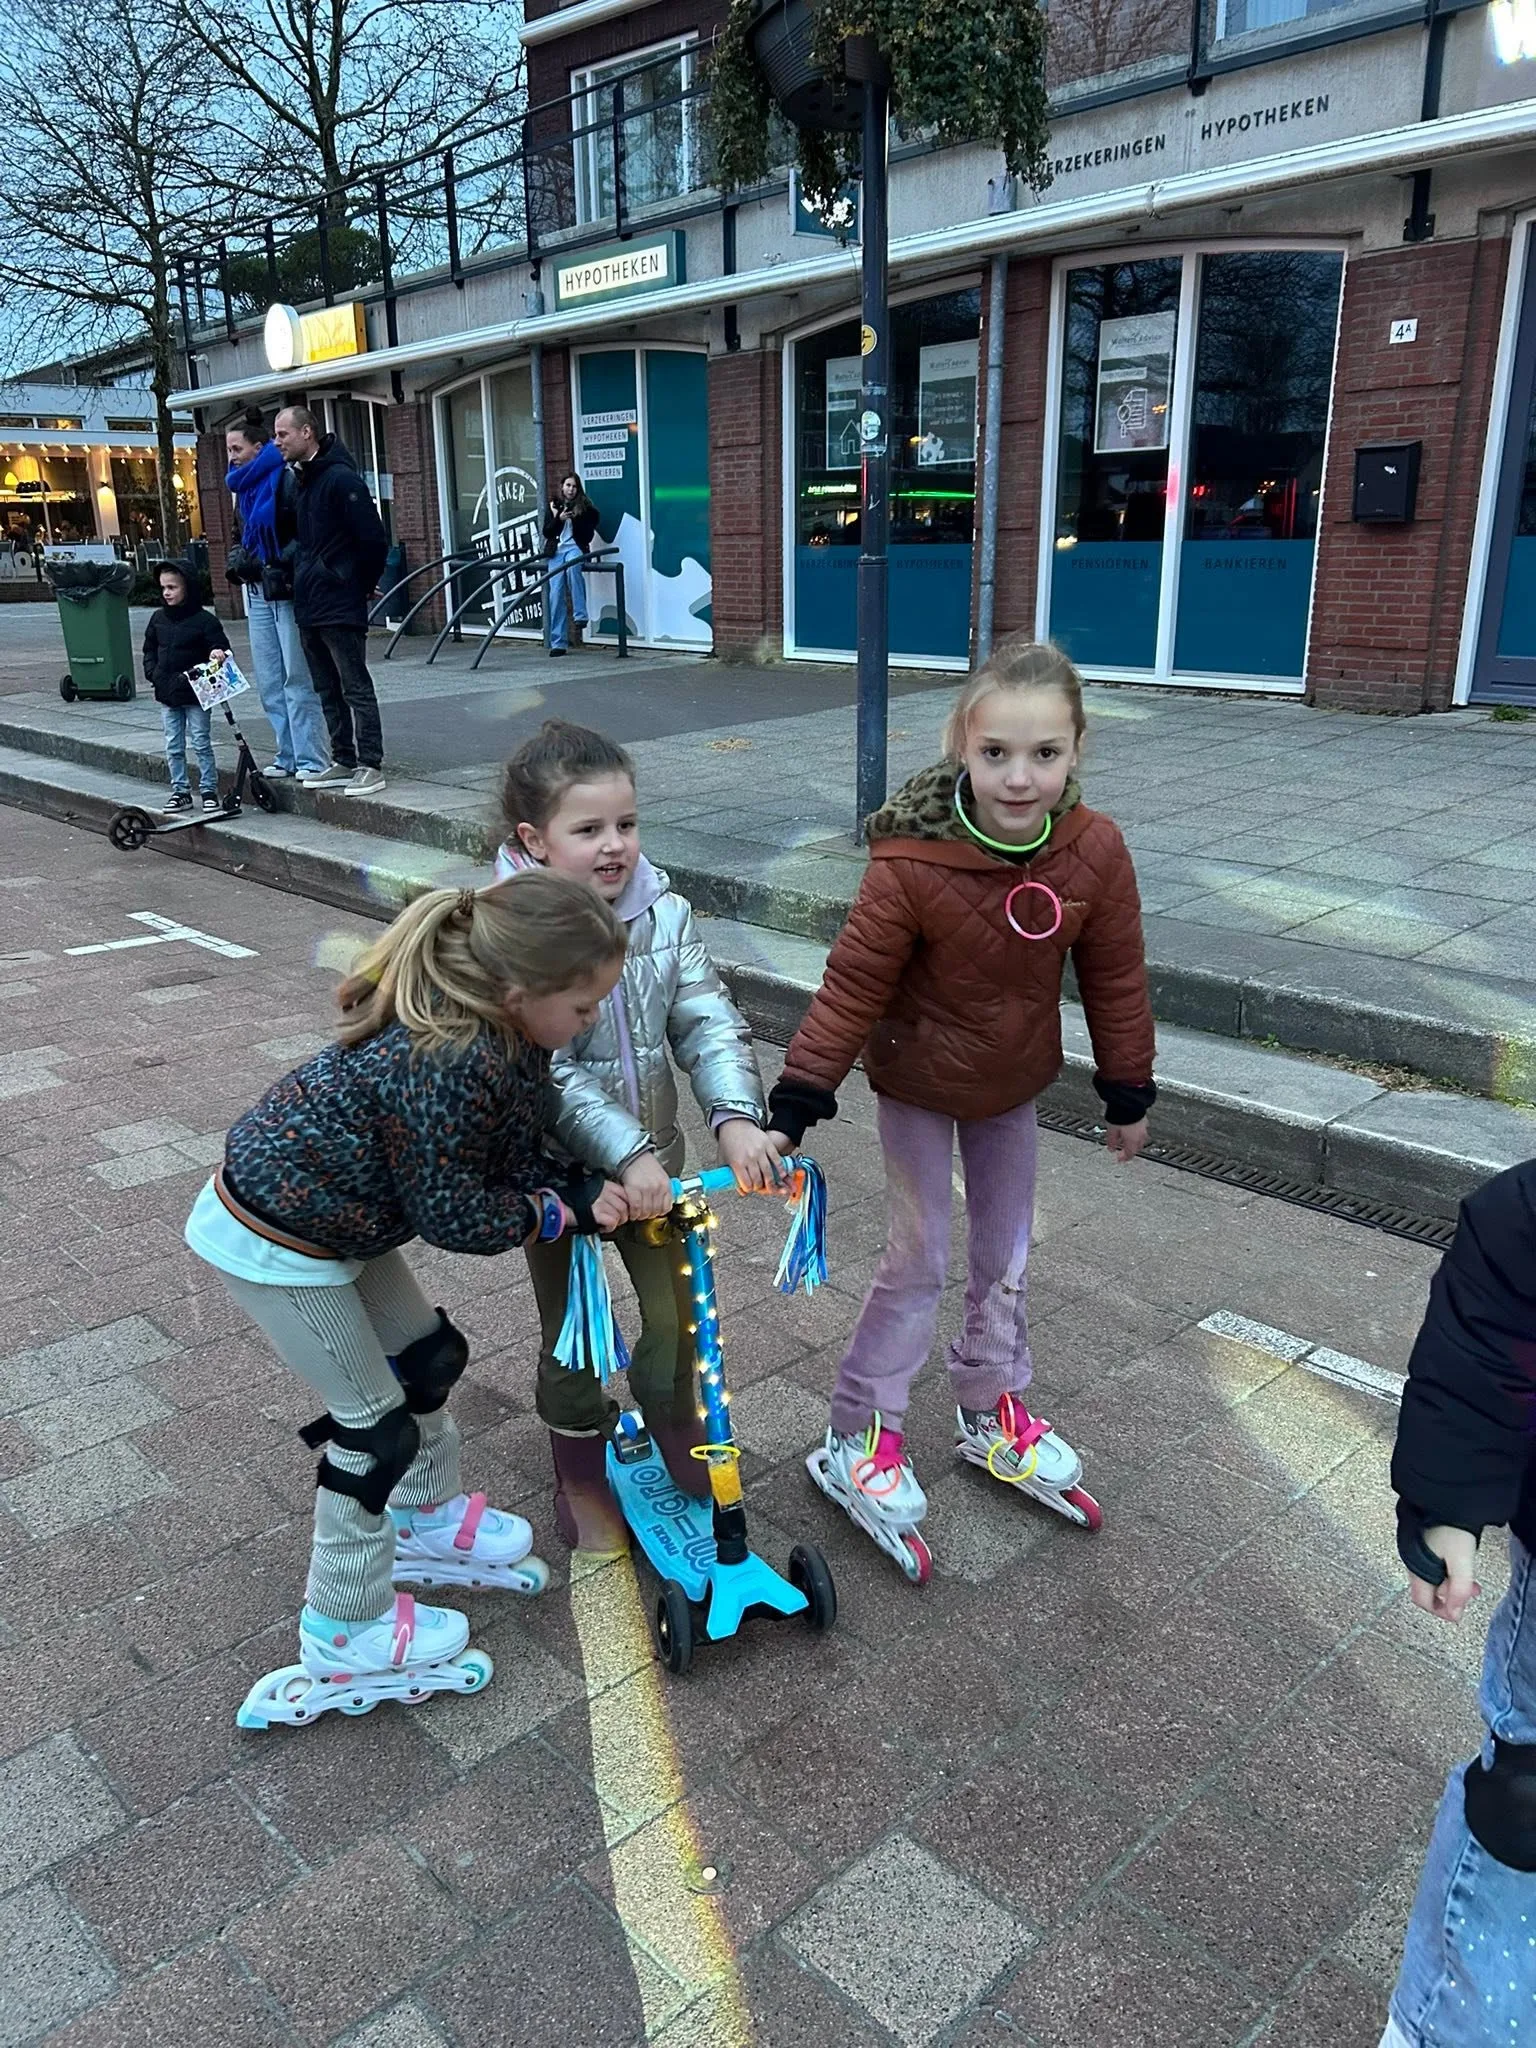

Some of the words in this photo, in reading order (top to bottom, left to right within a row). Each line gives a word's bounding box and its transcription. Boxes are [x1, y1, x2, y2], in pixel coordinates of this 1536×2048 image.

[1042, 133, 1166, 175] ERZEKERINGEN
[1201, 94, 1330, 141] HYPOTHEKEN
[564, 252, 660, 292] HYPOTHEKEN
[582, 411, 635, 425] VERZEKERINGEN
[584, 430, 627, 443] HYPOTHEKEN
[584, 449, 624, 461] PENSIOENEN
[585, 467, 621, 479] BANKIEREN
[1071, 558, 1150, 569] PENSIOENEN
[1204, 557, 1287, 569] BANKIEREN
[646, 1523, 680, 1557] maxi
